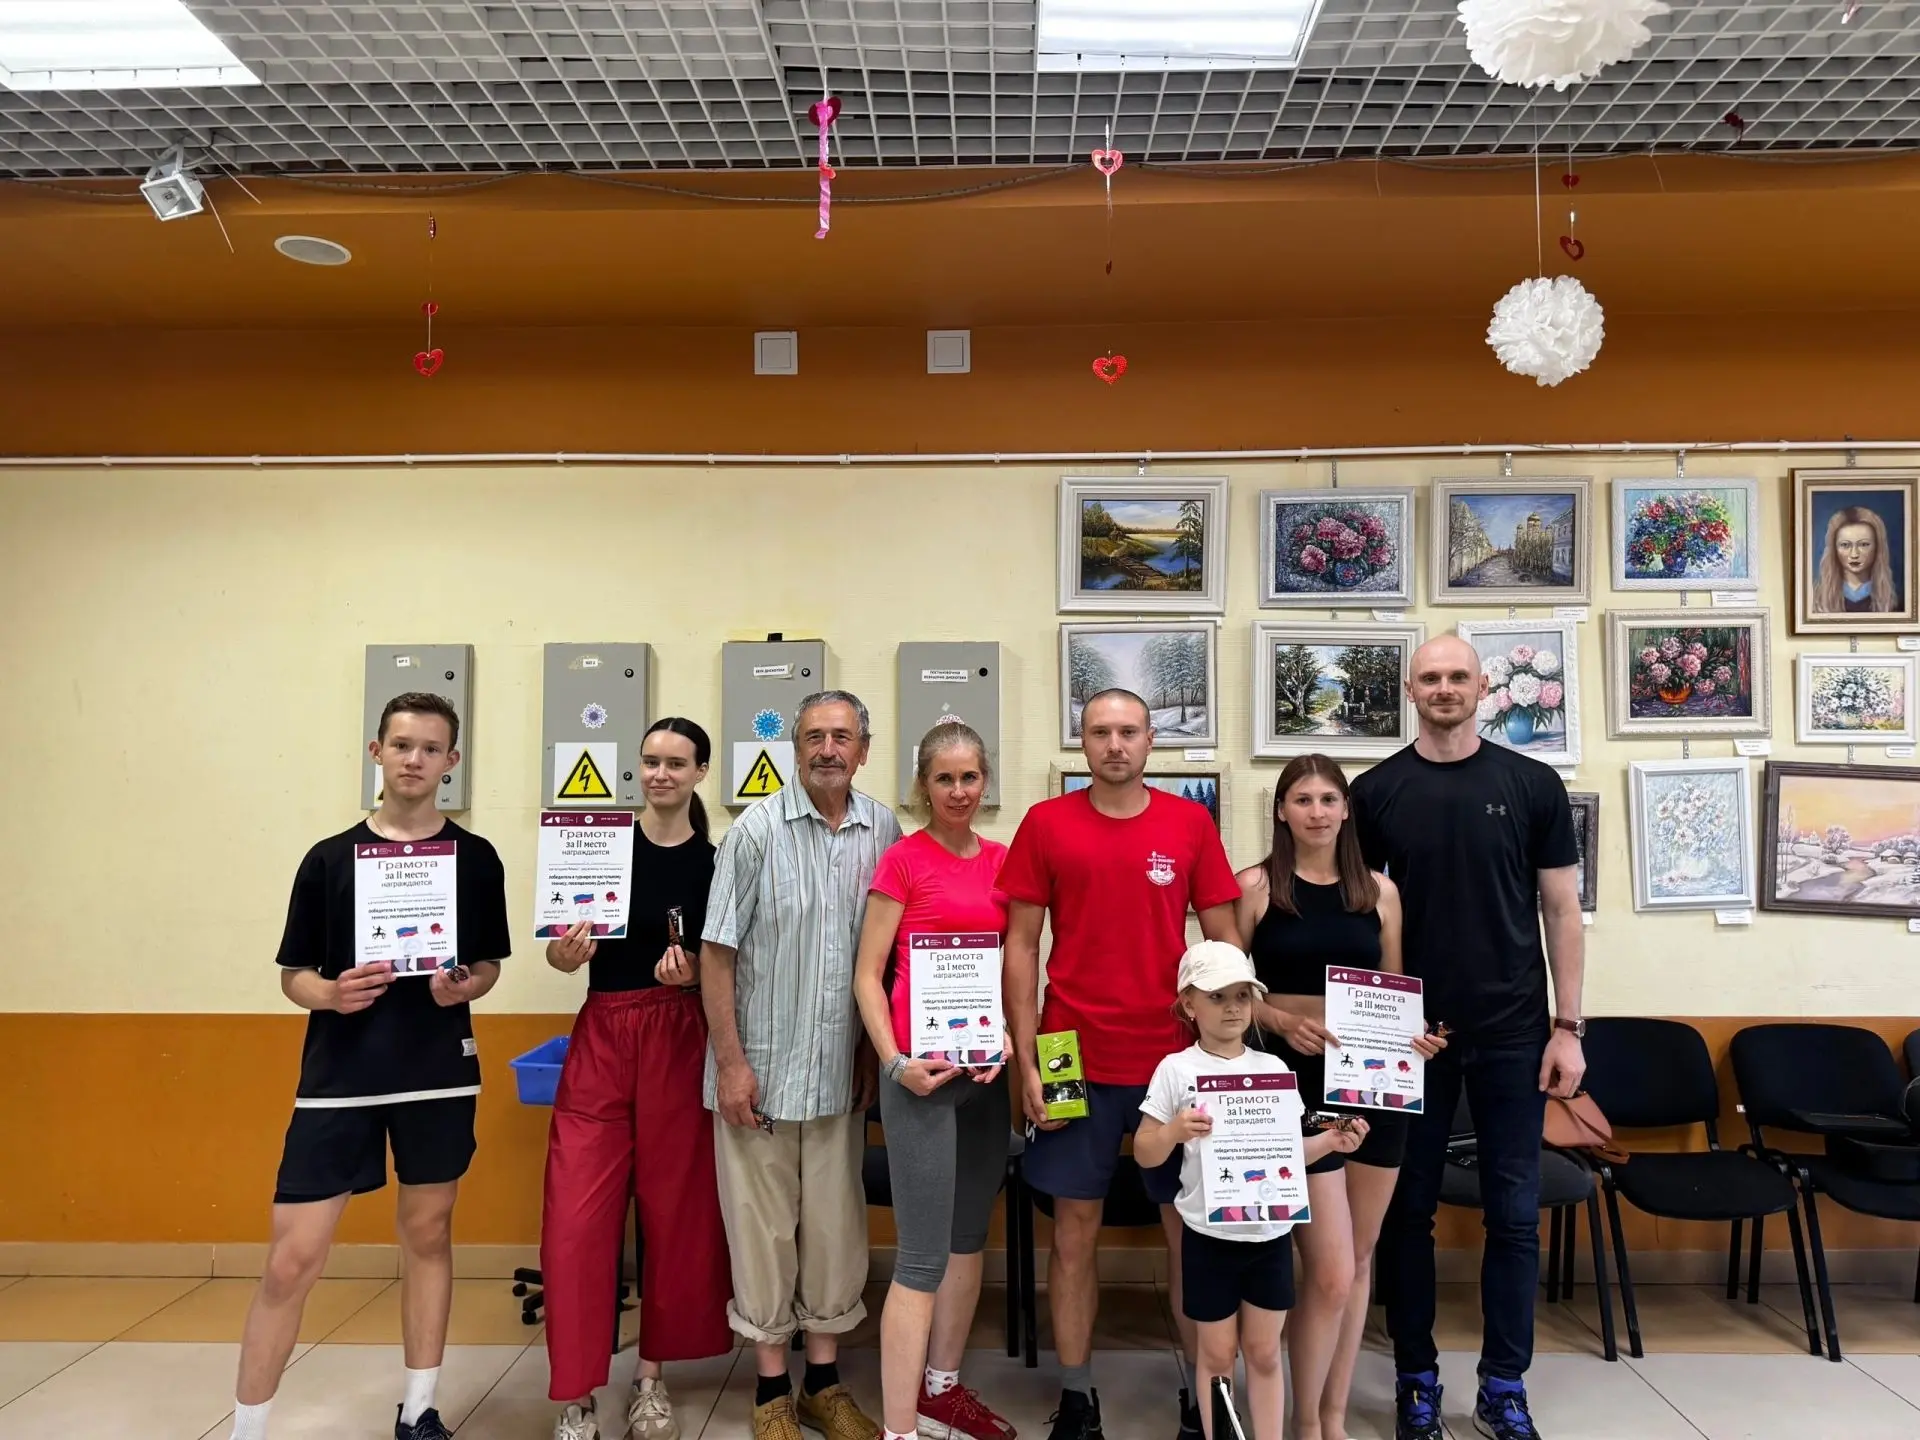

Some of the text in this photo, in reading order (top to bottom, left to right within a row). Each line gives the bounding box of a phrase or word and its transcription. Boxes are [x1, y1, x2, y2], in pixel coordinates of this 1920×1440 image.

[560, 830, 616, 839] Грамота
[378, 861, 437, 870] Грамота
[930, 952, 983, 962] Грамота
[1348, 987, 1405, 1003] Грамота
[1374, 1003, 1397, 1012] место
[1350, 1010, 1400, 1020] награждается
[1219, 1095, 1280, 1104] Грамота
